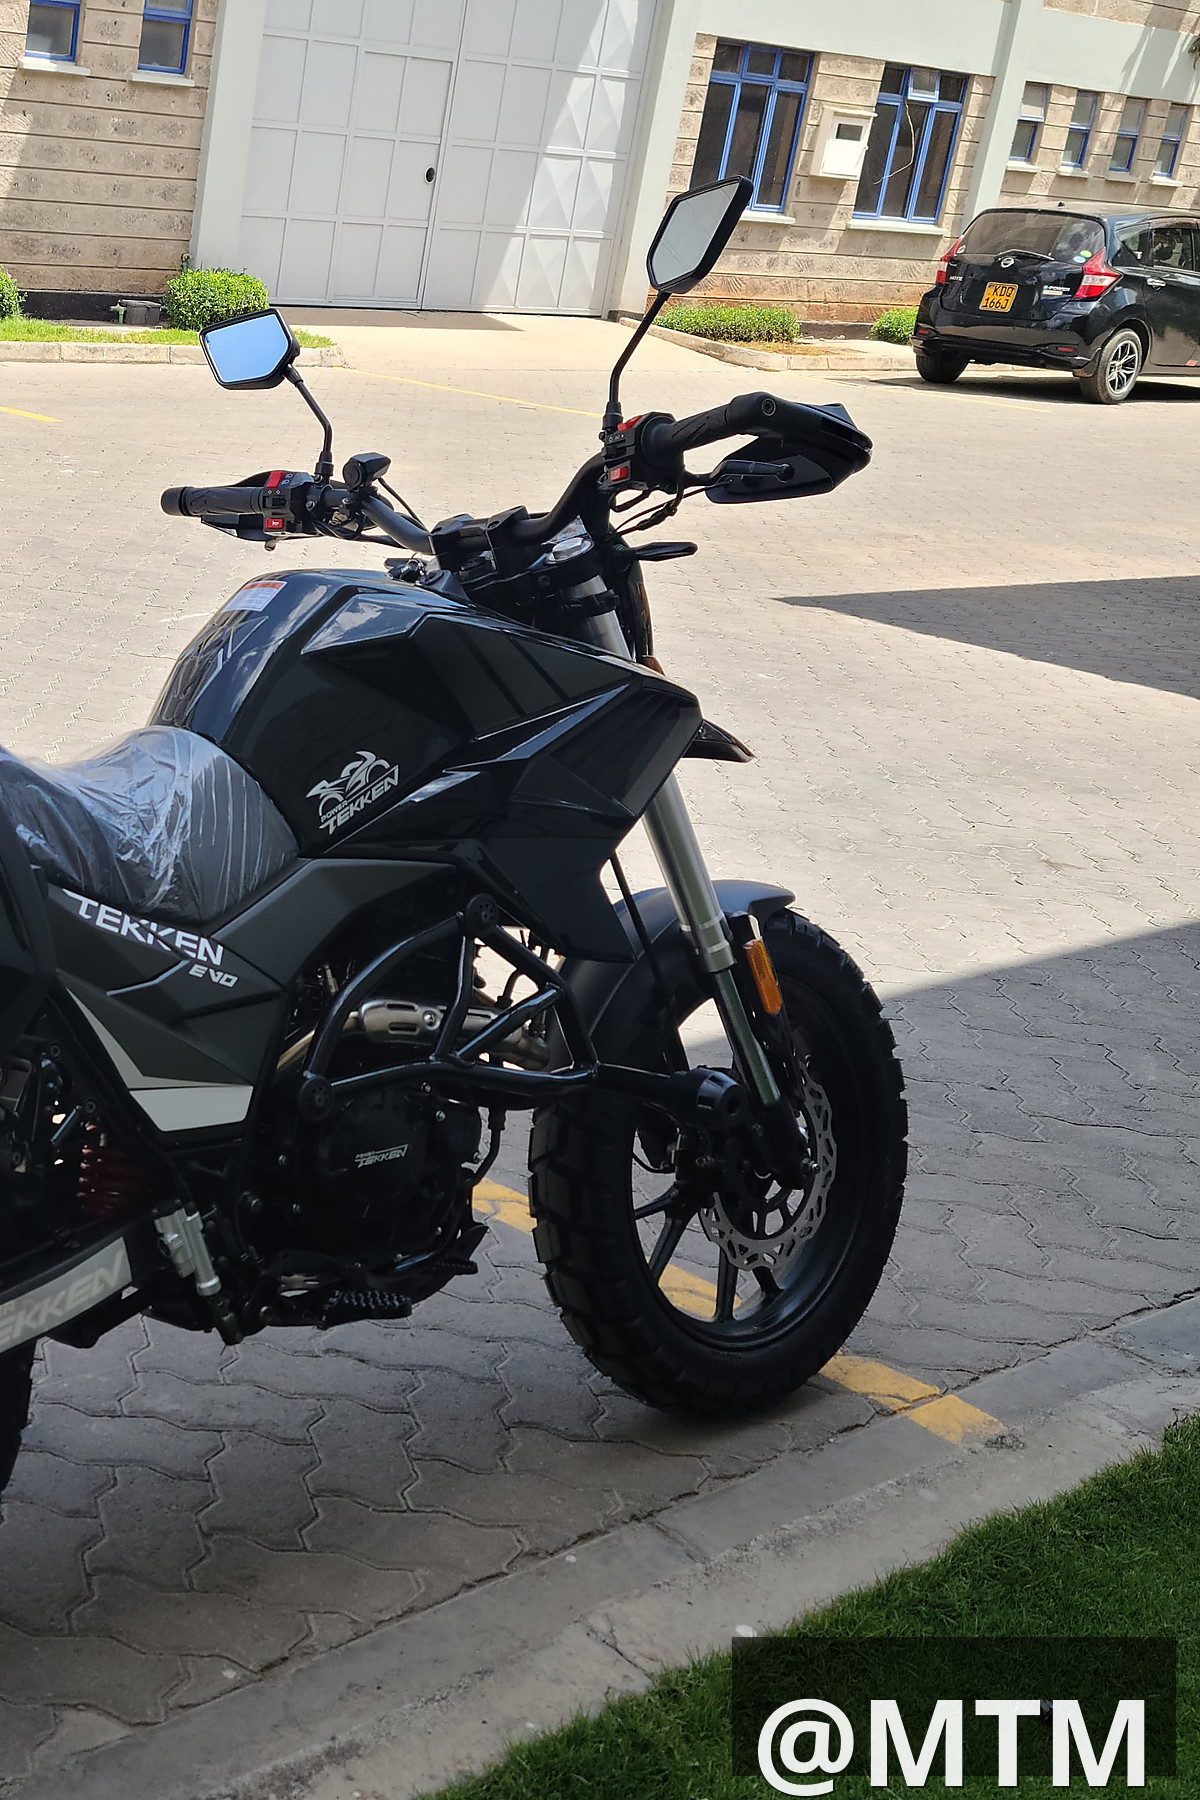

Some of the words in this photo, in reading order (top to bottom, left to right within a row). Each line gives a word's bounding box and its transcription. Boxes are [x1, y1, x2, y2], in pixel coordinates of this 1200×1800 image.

[982, 297, 1010, 309] 166J
[992, 285, 1015, 297] KDQ
[318, 764, 400, 835] TEKKEN
[320, 800, 349, 823] POWER
[61, 887, 225, 966] TEKKEN
[188, 963, 239, 988] EVO
[354, 1143, 409, 1169] TEKKEN
